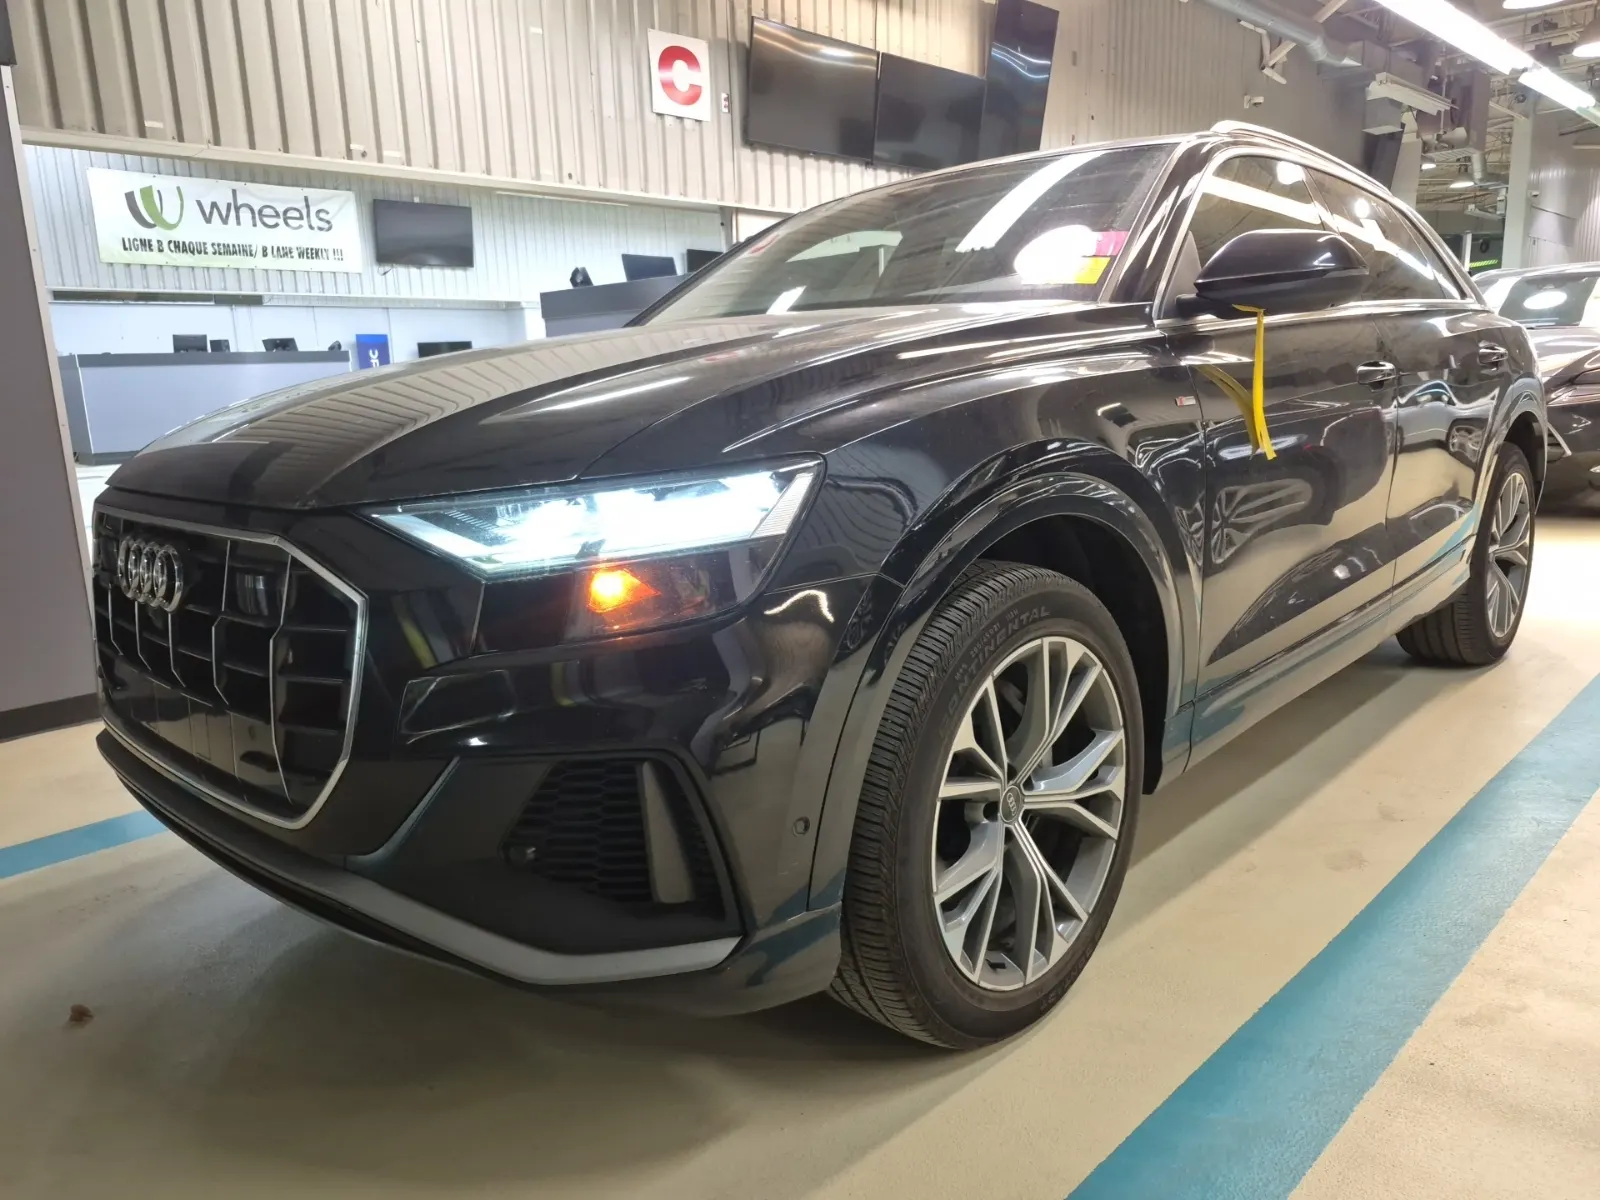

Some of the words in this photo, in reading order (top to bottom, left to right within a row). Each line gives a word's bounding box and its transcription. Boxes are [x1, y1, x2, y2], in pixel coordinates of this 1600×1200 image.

[658, 45, 702, 106] C
[195, 188, 334, 232] wheels
[121, 237, 154, 252] LIGNE
[156, 239, 165, 253] B
[167, 239, 209, 256] CHAQUE
[261, 245, 269, 258] B
[296, 246, 330, 260] WEEKLY
